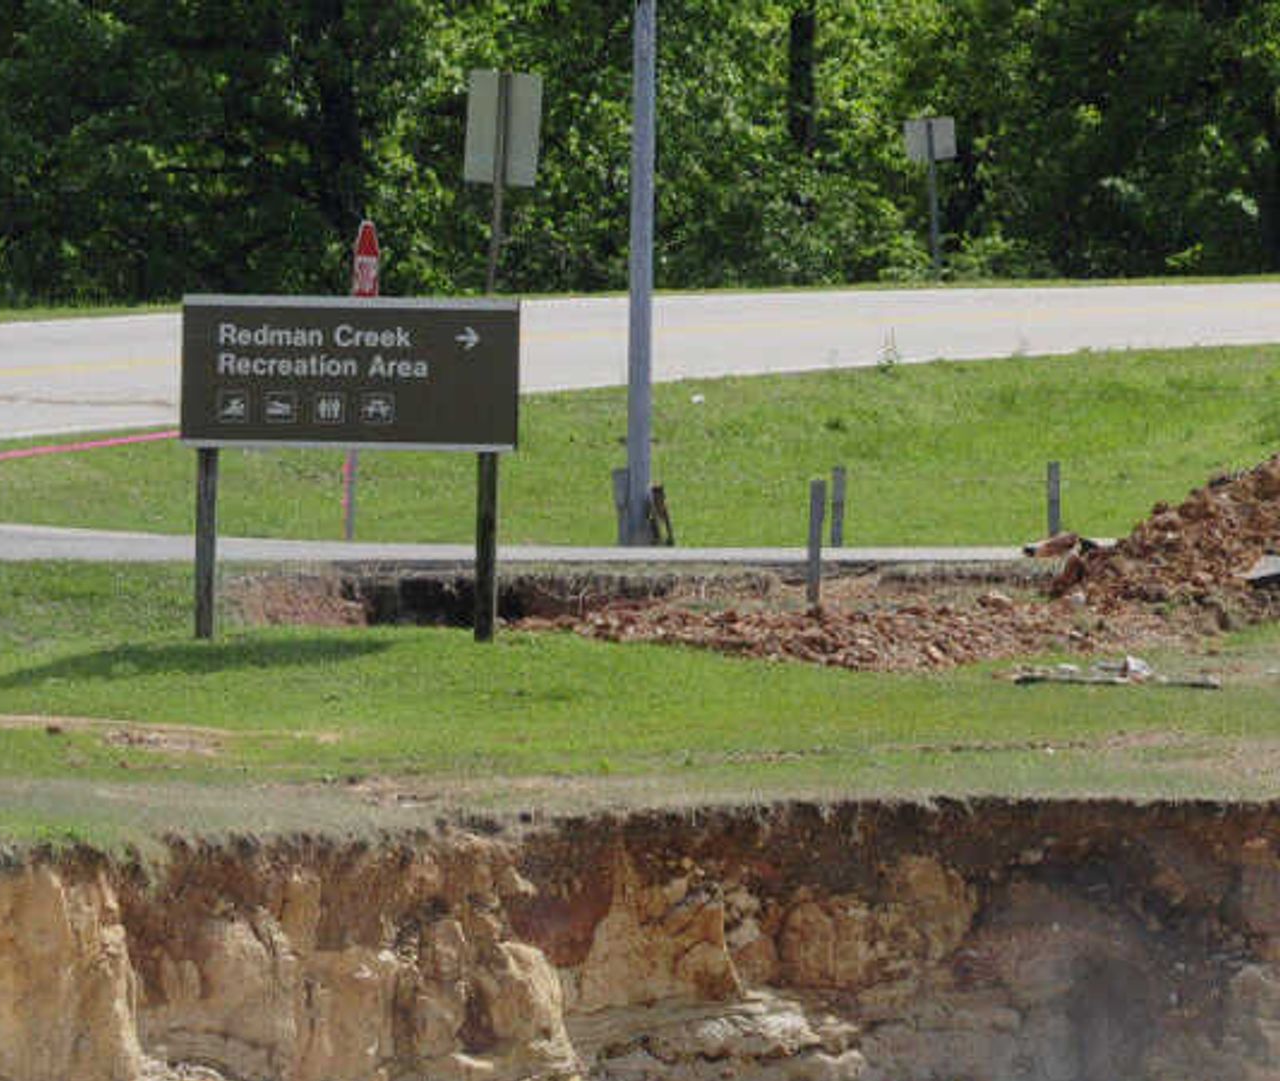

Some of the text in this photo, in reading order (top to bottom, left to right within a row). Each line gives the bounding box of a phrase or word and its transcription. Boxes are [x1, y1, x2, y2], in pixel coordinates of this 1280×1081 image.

[218, 323, 411, 347] Redman Creek
[217, 353, 428, 377] Recreation Area
